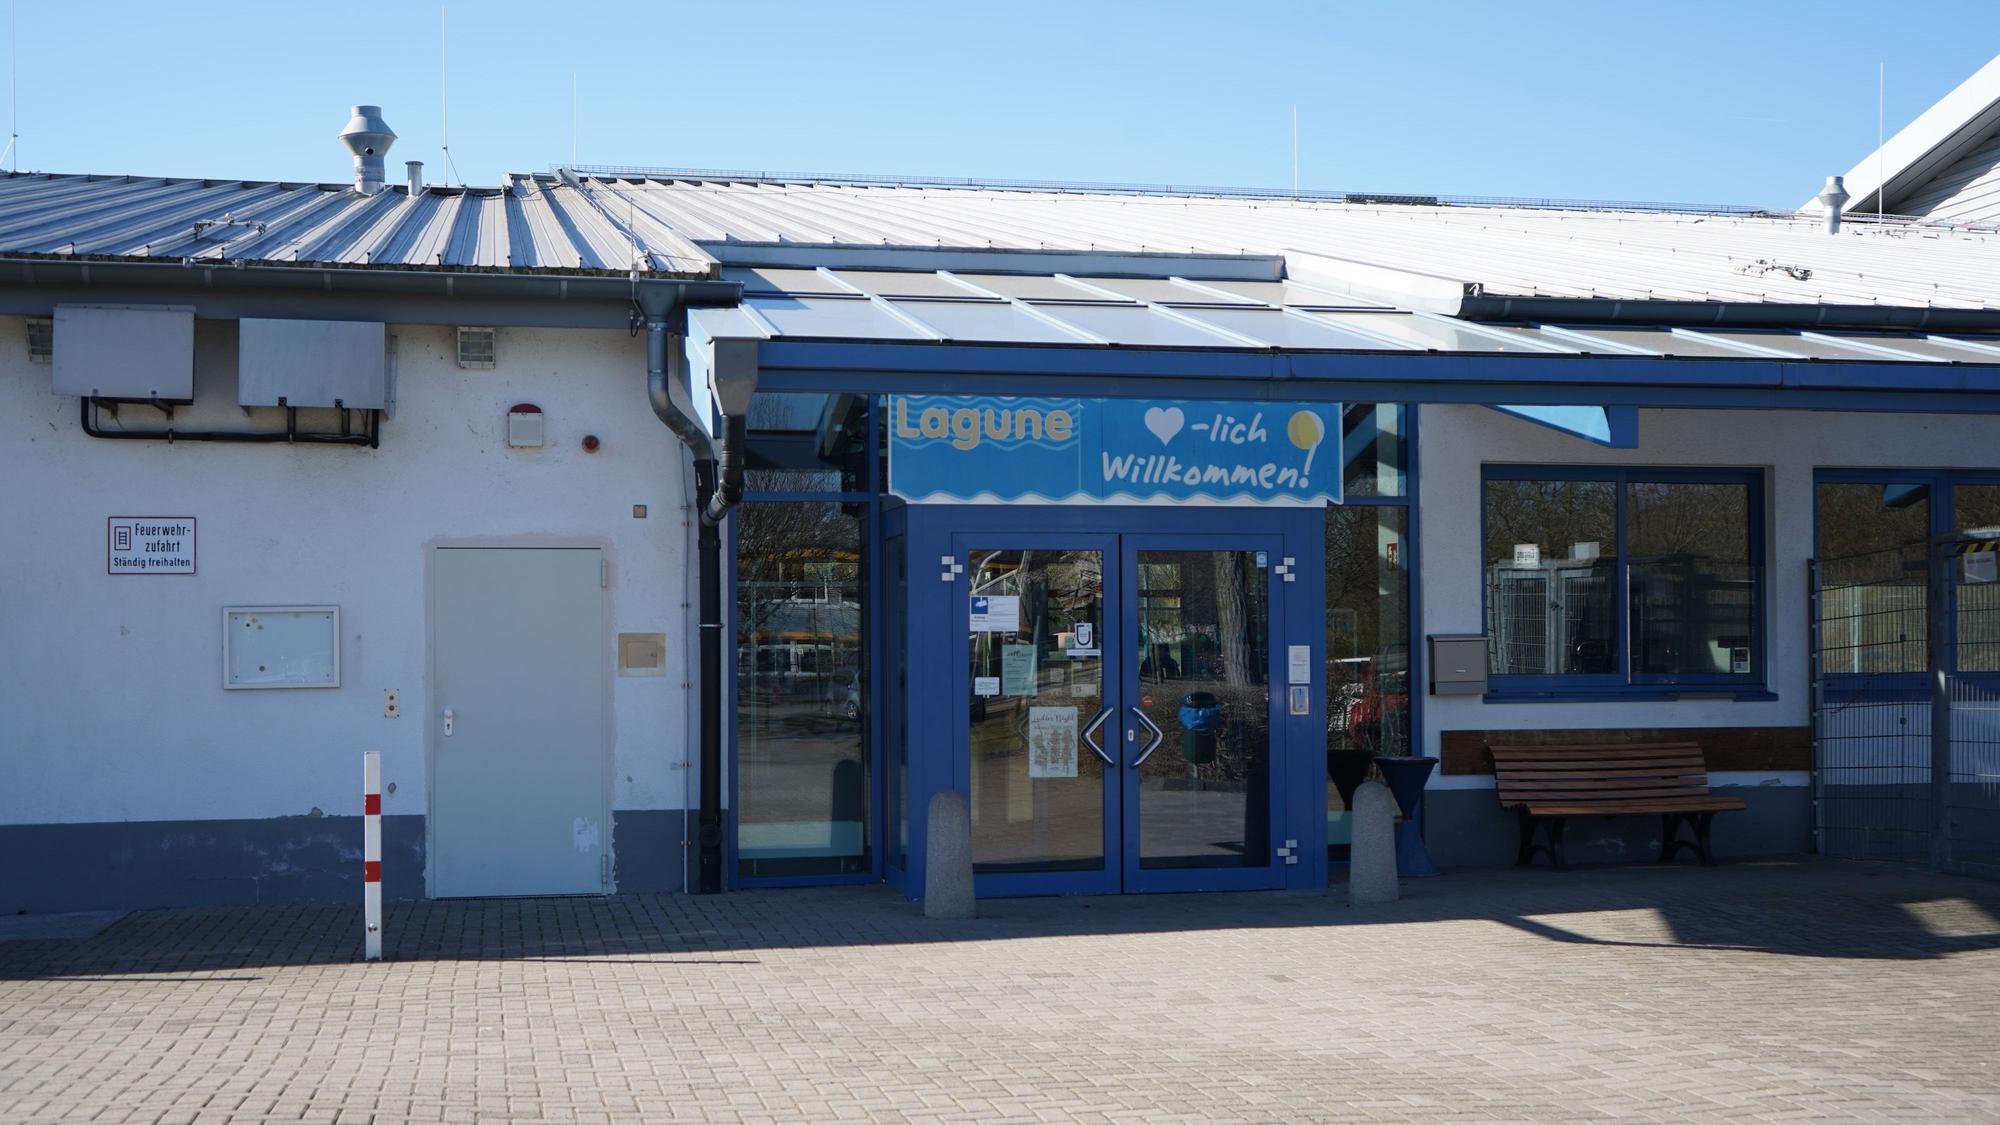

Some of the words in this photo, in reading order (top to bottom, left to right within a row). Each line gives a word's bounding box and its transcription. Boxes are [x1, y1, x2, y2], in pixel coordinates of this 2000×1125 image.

[896, 399, 1073, 450] Lagune
[1102, 442, 1318, 489] Willkommen!
[135, 522, 191, 536] Feuerwehr-
[145, 539, 181, 552] zufahrt
[113, 557, 146, 569] Ständig
[148, 557, 191, 567] freihalten
